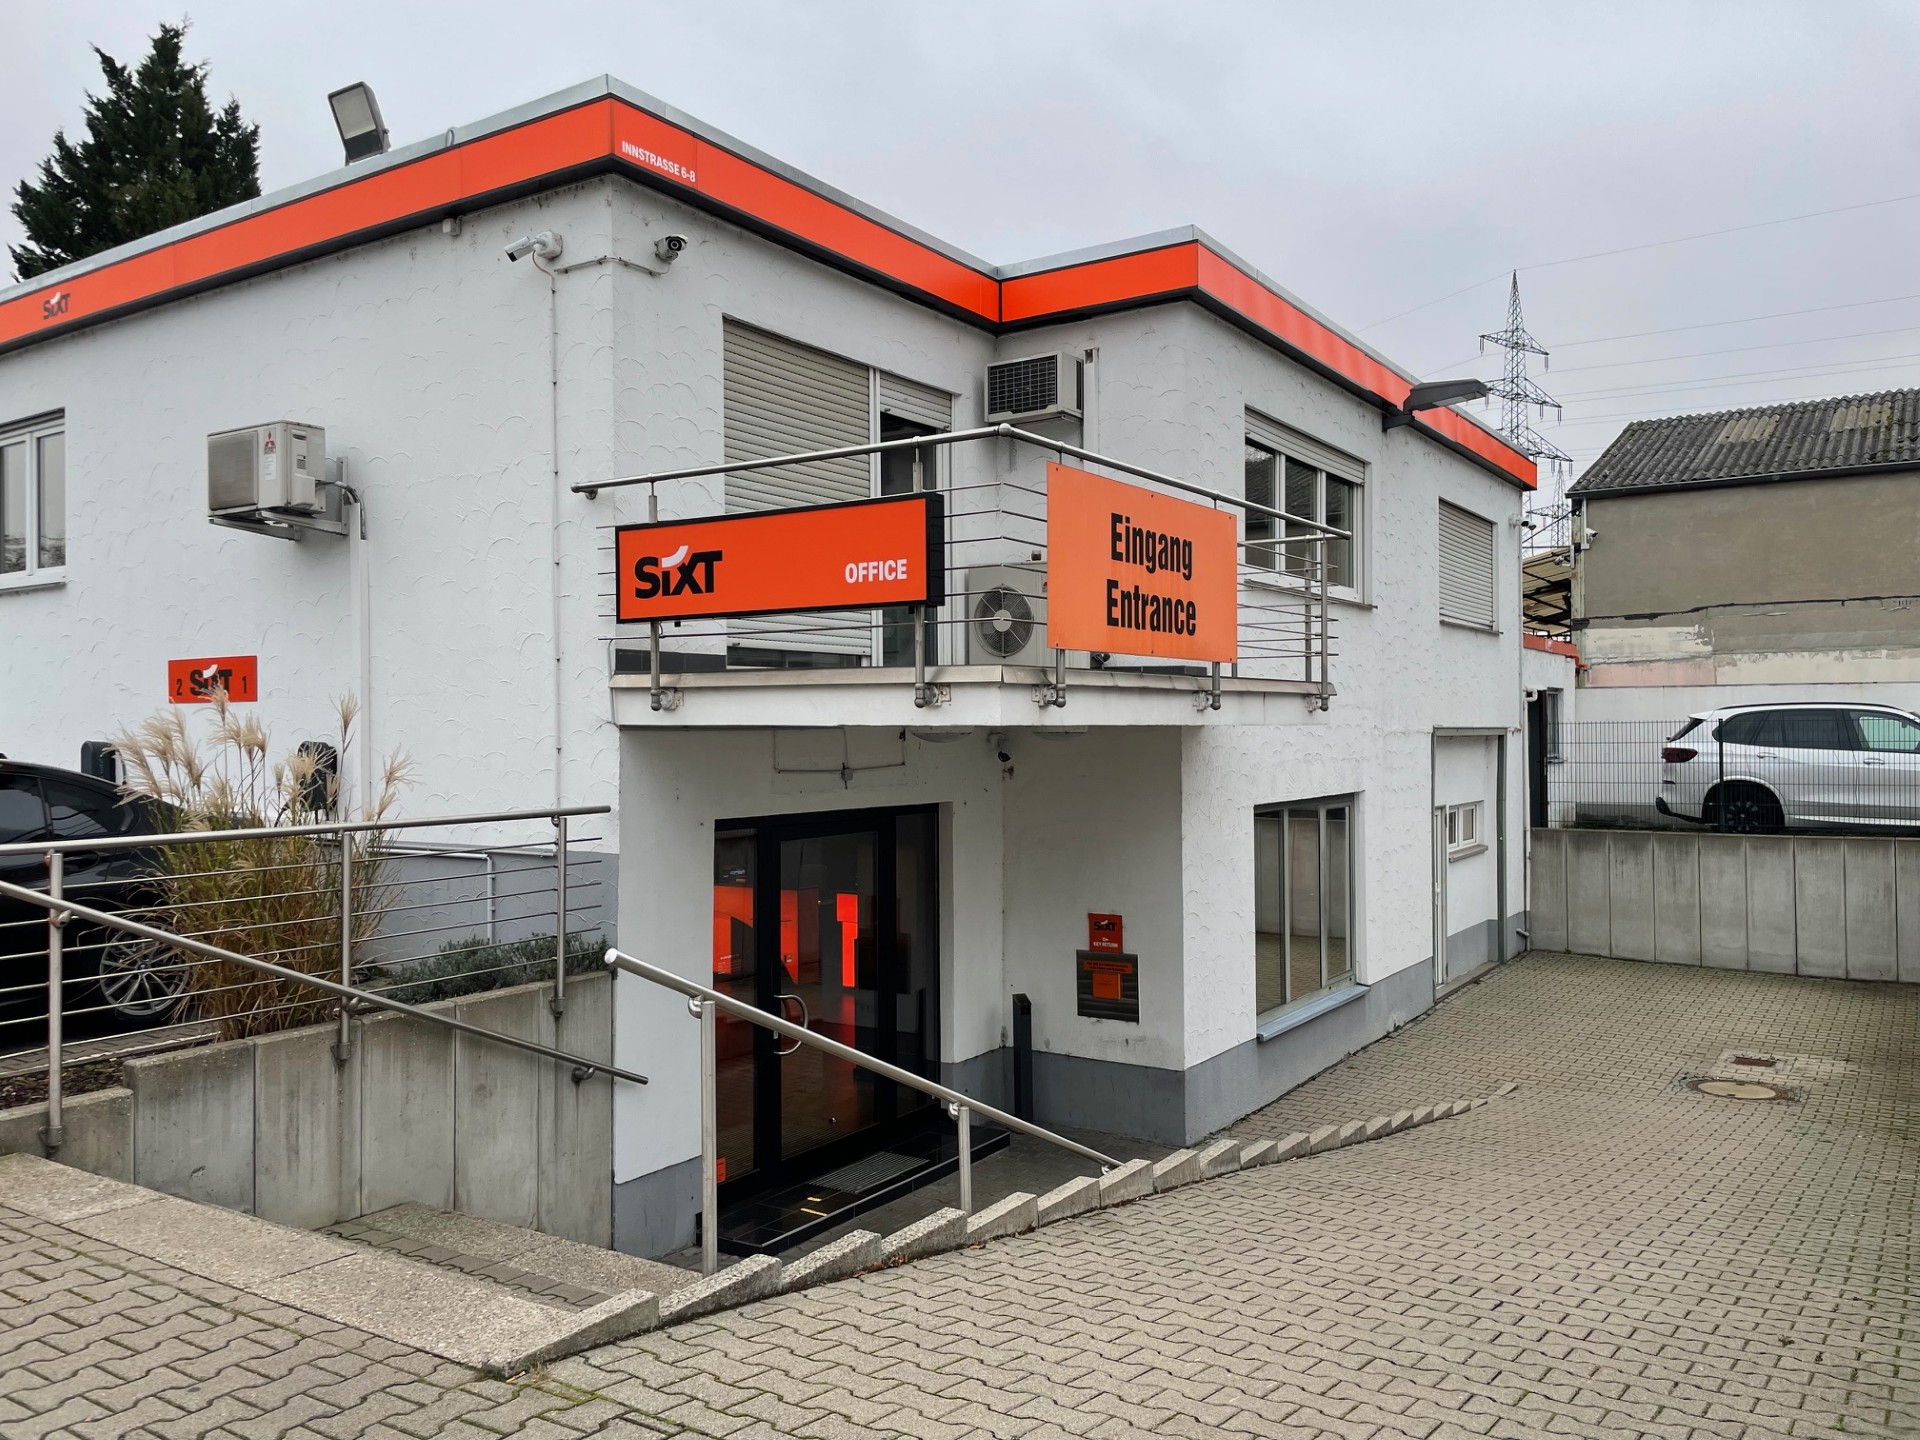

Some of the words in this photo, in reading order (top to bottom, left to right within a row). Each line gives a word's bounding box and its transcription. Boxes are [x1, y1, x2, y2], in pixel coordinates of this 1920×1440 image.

[622, 141, 680, 176] INNSTRASSE
[681, 167, 696, 182] 6-8
[634, 545, 723, 599] SIXT
[845, 559, 907, 584] OFFICE
[1111, 512, 1192, 581] Eingang
[1106, 578, 1196, 636] Entrance
[176, 678, 183, 696] 2
[242, 676, 247, 694] 1
